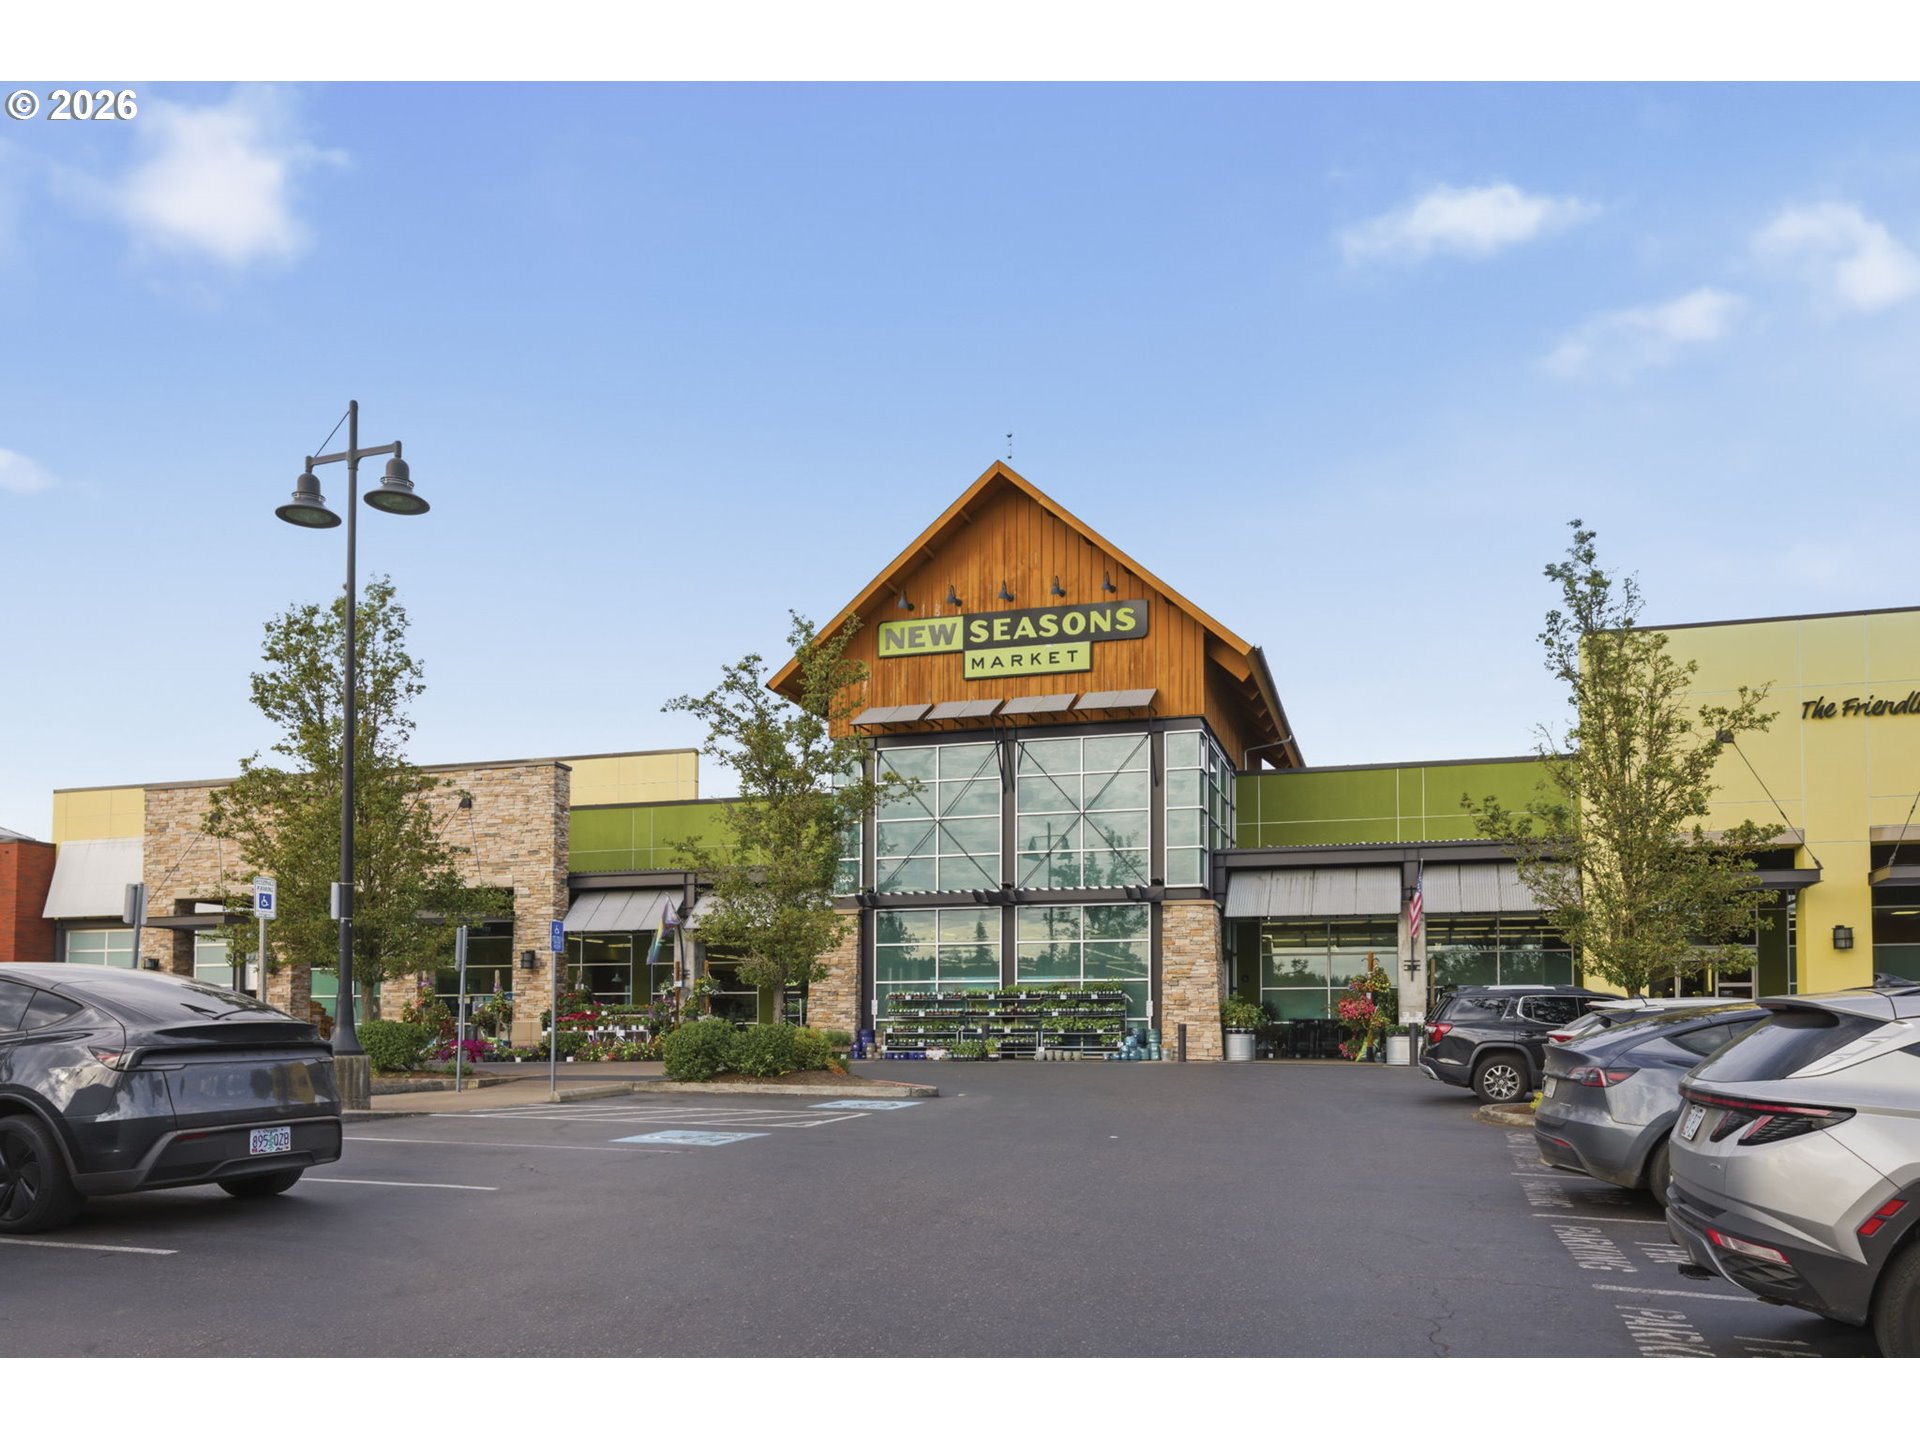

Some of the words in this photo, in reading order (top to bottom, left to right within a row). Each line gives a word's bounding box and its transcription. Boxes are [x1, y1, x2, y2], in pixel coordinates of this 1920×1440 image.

[884, 622, 958, 651] NEW
[969, 606, 1137, 644] SEASONS
[971, 649, 1079, 670] MARKET
[1801, 695, 1837, 720] The
[1842, 690, 1920, 718] Friendl
[252, 1134, 269, 1149] 895
[1551, 1224, 1638, 1273] PARKING
